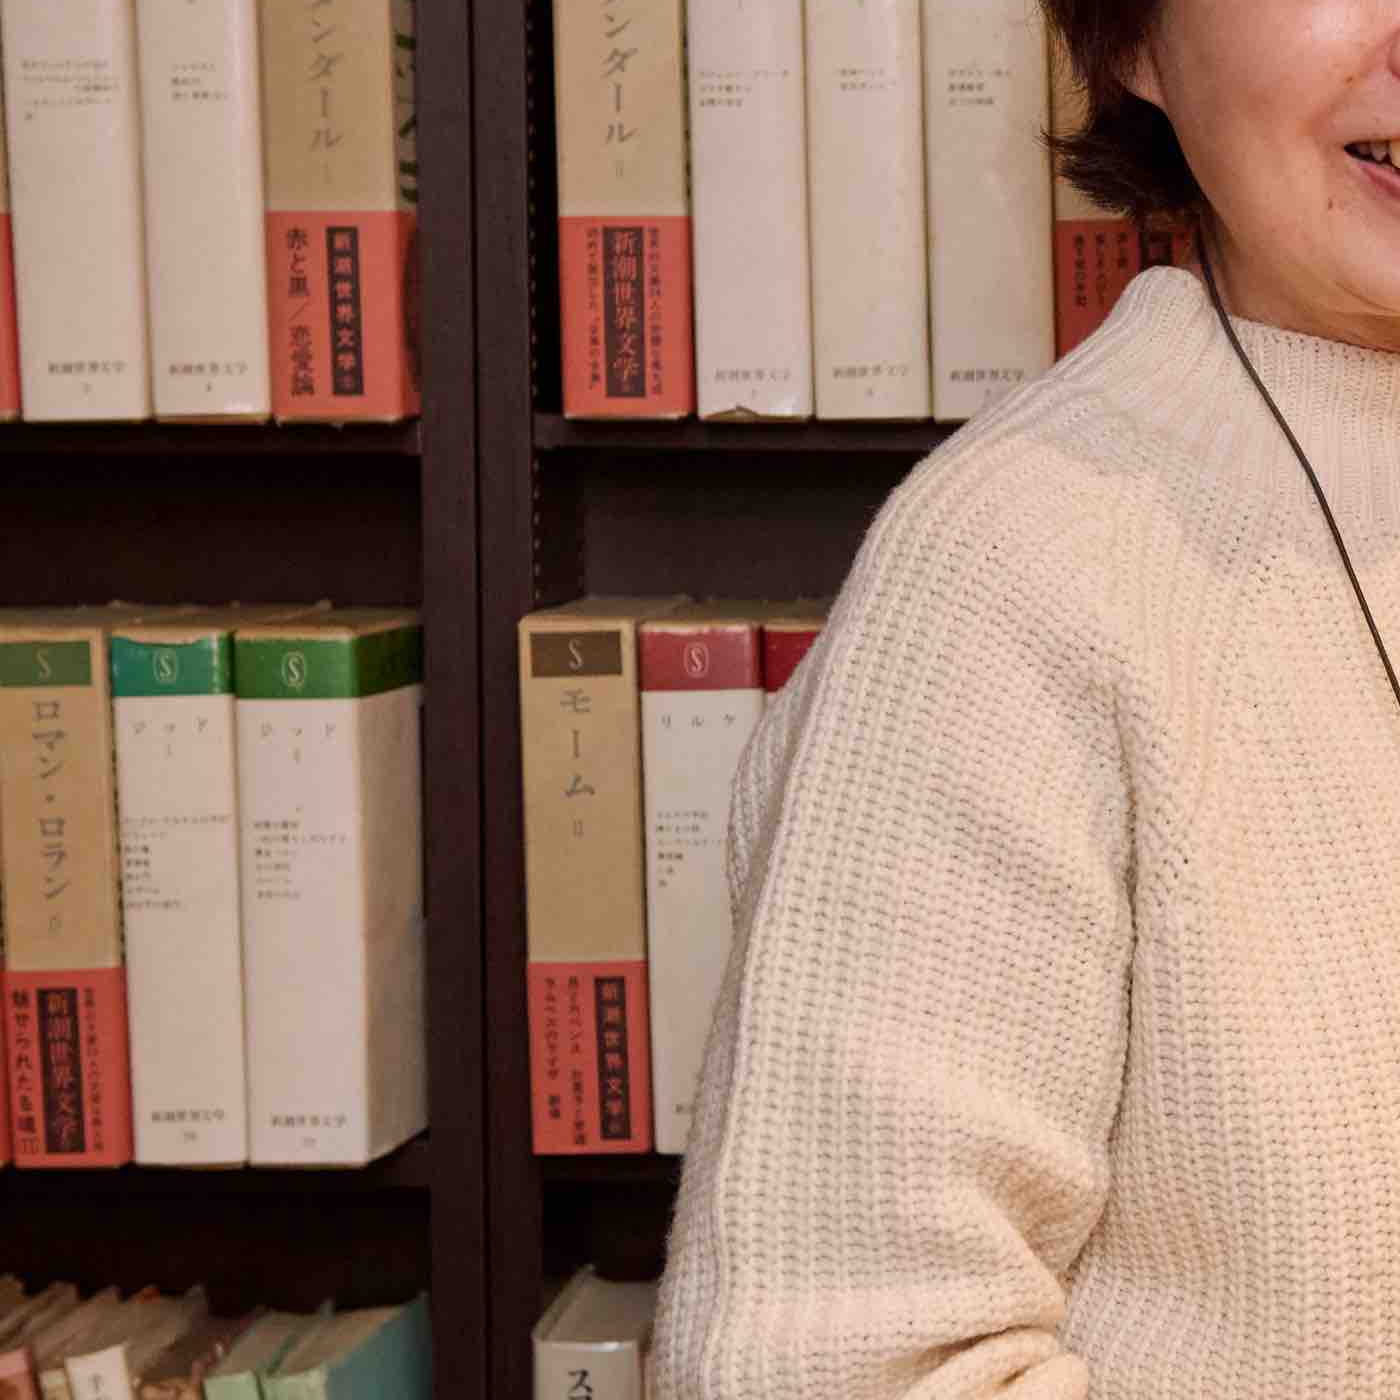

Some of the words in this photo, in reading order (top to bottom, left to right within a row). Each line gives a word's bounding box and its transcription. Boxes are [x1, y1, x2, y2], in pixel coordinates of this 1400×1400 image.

[610, 230, 641, 375] 新潮世界文学
[568, 638, 584, 671] S
[261, 724, 336, 739] ジッド
[560, 688, 596, 798] モーム
[660, 714, 737, 728] リルケ
[31, 700, 73, 901] ロマン・ロラン
